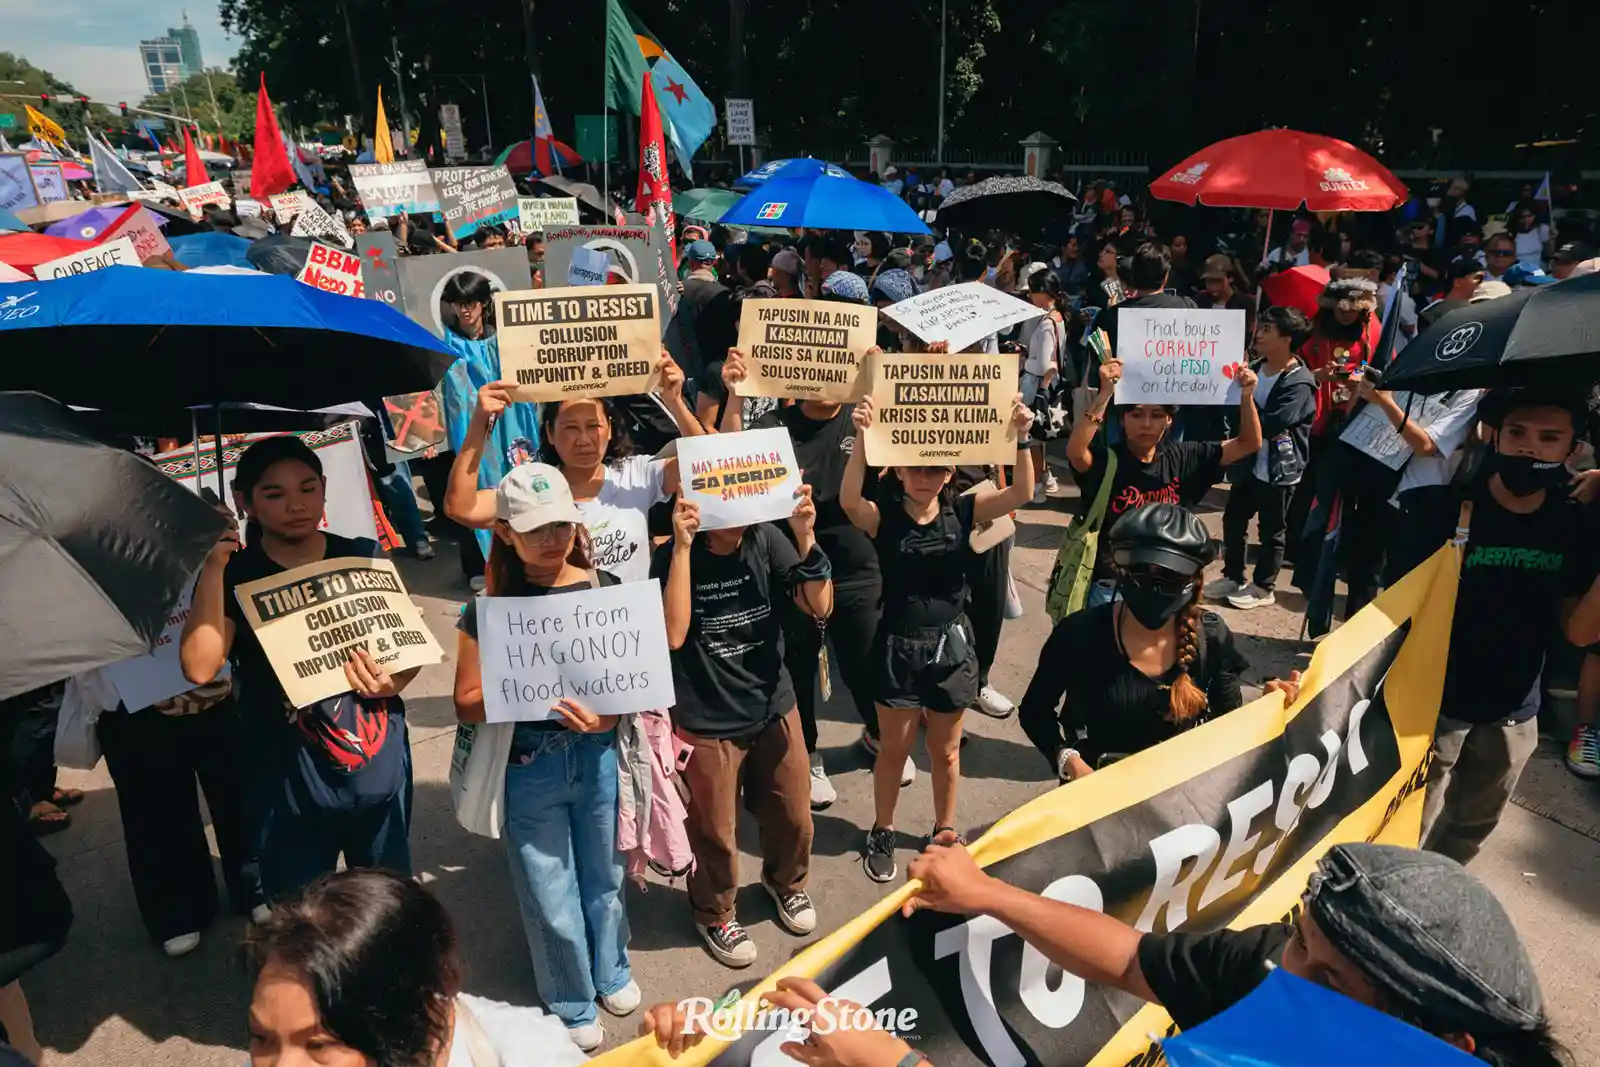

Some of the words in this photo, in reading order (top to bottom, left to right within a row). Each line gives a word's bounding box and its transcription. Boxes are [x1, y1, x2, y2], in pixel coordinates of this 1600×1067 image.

[310, 244, 361, 277] BBM
[375, 290, 396, 304] NO
[508, 301, 554, 323] TIME
[557, 299, 581, 320] TO
[586, 296, 648, 319] RESIST
[758, 308, 810, 324] TAPUSIN
[814, 311, 831, 326] NA
[833, 313, 860, 328] ANG
[540, 325, 618, 346] COLLUSION
[769, 326, 845, 346] KASAKIMAN
[1144, 318, 1179, 338] That
[1184, 319, 1208, 339] boy
[1210, 324, 1222, 336] is
[536, 343, 628, 365] CORRUPTION
[751, 344, 793, 361] KRISIS
[796, 348, 813, 362] SA
[816, 350, 860, 371] KLIMA,
[1144, 340, 1219, 358] CORRUPT
[516, 365, 588, 386] IMPUNITY
[592, 366, 602, 380] &
[606, 360, 650, 378] GREED
[761, 364, 848, 384] SOLUSYONAN!
[883, 364, 945, 380] TAPUSIN
[949, 364, 969, 380] NA
[972, 364, 1001, 380] ANG
[1153, 359, 1177, 376] Got
[1180, 358, 1211, 376] PTSD
[561, 381, 609, 393] GREENPEACE
[784, 384, 823, 393] GREENPEACE
[899, 385, 985, 403] KASAKIMAN
[1141, 381, 1160, 394] on
[1164, 377, 1189, 394] the
[1190, 378, 1219, 397] daily
[879, 408, 927, 424] KRISIS
[931, 408, 949, 424] SA
[954, 408, 1003, 425] KLIMA,
[891, 429, 990, 445] SOLUSYONAN!
[691, 459, 713, 476] MAY
[717, 454, 753, 470] TATALO
[755, 452, 768, 467] PA
[769, 451, 783, 465] BA
[919, 450, 962, 458] GREENPEACE
[691, 476, 721, 491] SA
[724, 467, 788, 486] KORAP
[721, 487, 735, 502] SA
[738, 481, 770, 499] PINAS?
[259, 582, 319, 617] TIME
[318, 573, 349, 598] TO
[348, 570, 398, 591] RESIST
[305, 595, 391, 632] COLLUSION
[507, 611, 564, 637] Here
[573, 605, 629, 629] from
[307, 612, 405, 653] CORRUPTION
[376, 637, 392, 653] &
[391, 630, 427, 648] GREED
[375, 651, 401, 666] PEACE
[506, 630, 641, 669] HAGONOY
[501, 675, 565, 705] flood
[569, 668, 650, 697] waters
[934, 875, 1104, 1067] TO
